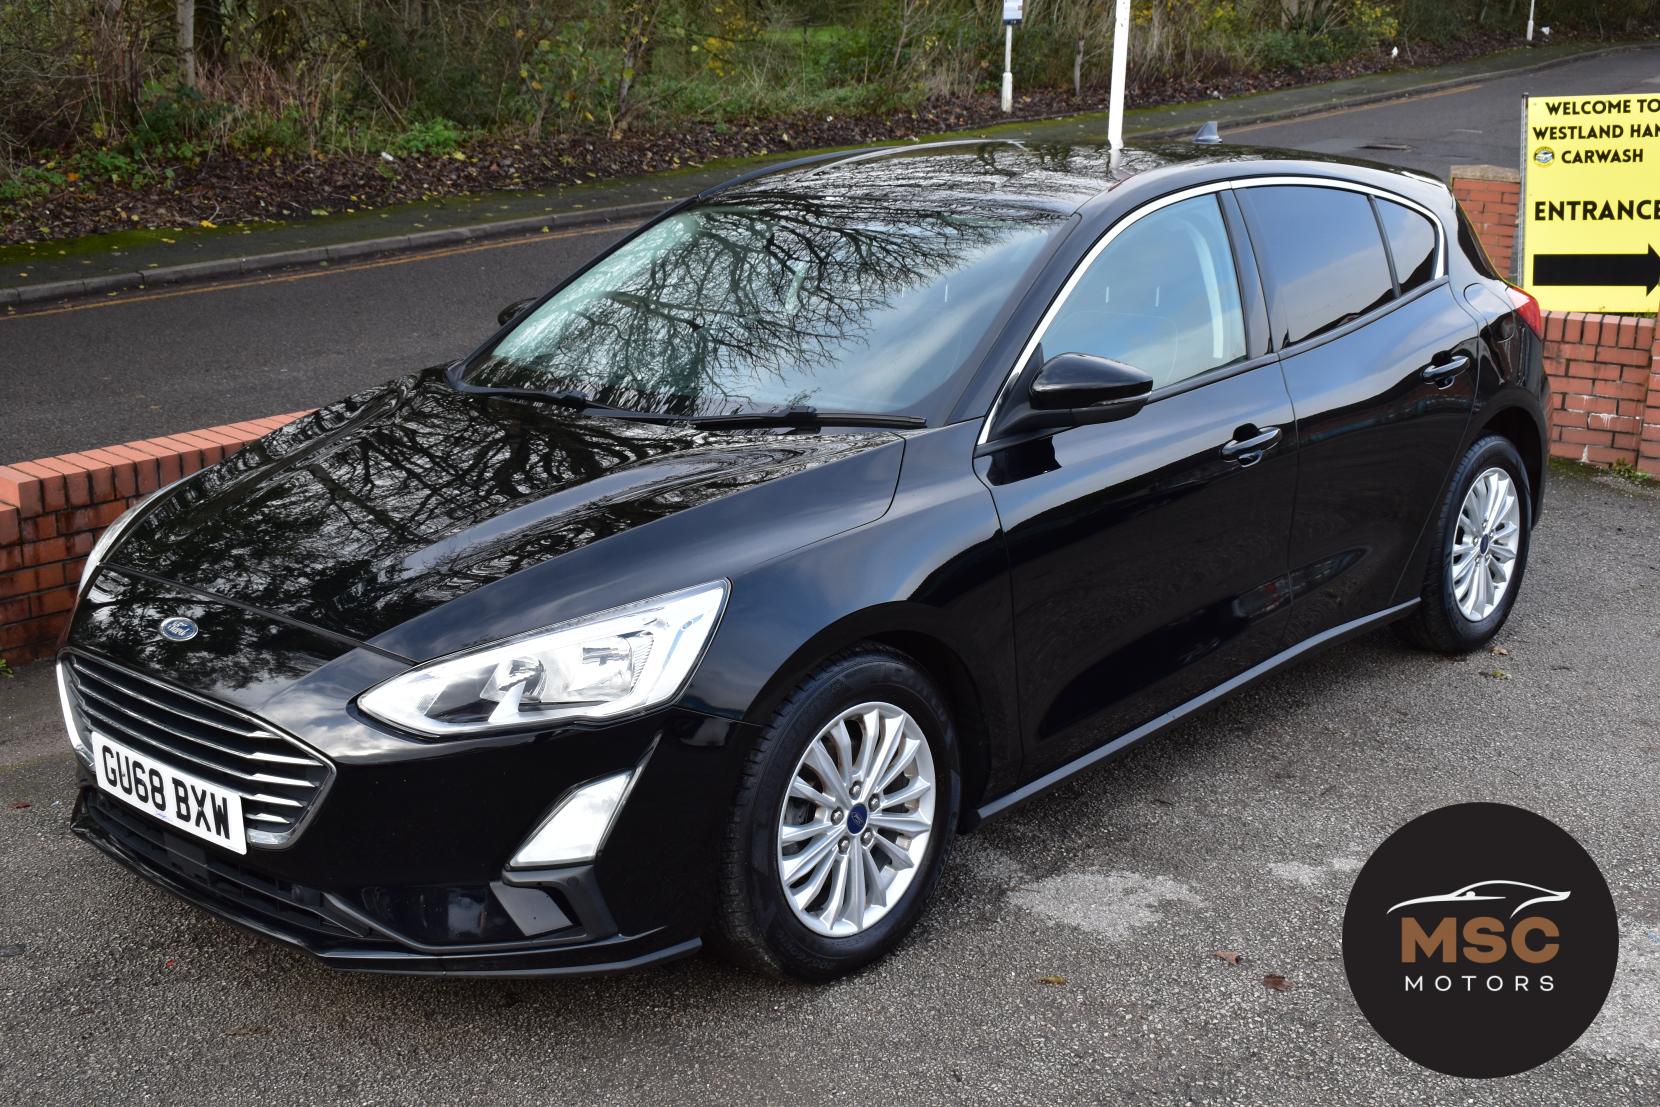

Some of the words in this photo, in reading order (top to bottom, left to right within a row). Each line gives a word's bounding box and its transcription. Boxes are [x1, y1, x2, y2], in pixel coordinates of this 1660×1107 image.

[1545, 99, 1631, 115] WELCOME
[1637, 98, 1660, 113] TO
[1533, 124, 1623, 140] WESTLAND
[1561, 149, 1643, 163] CARWASH
[1535, 199, 1660, 221] ENTRANCE
[102, 744, 167, 812] GU68
[171, 776, 230, 840] BXW
